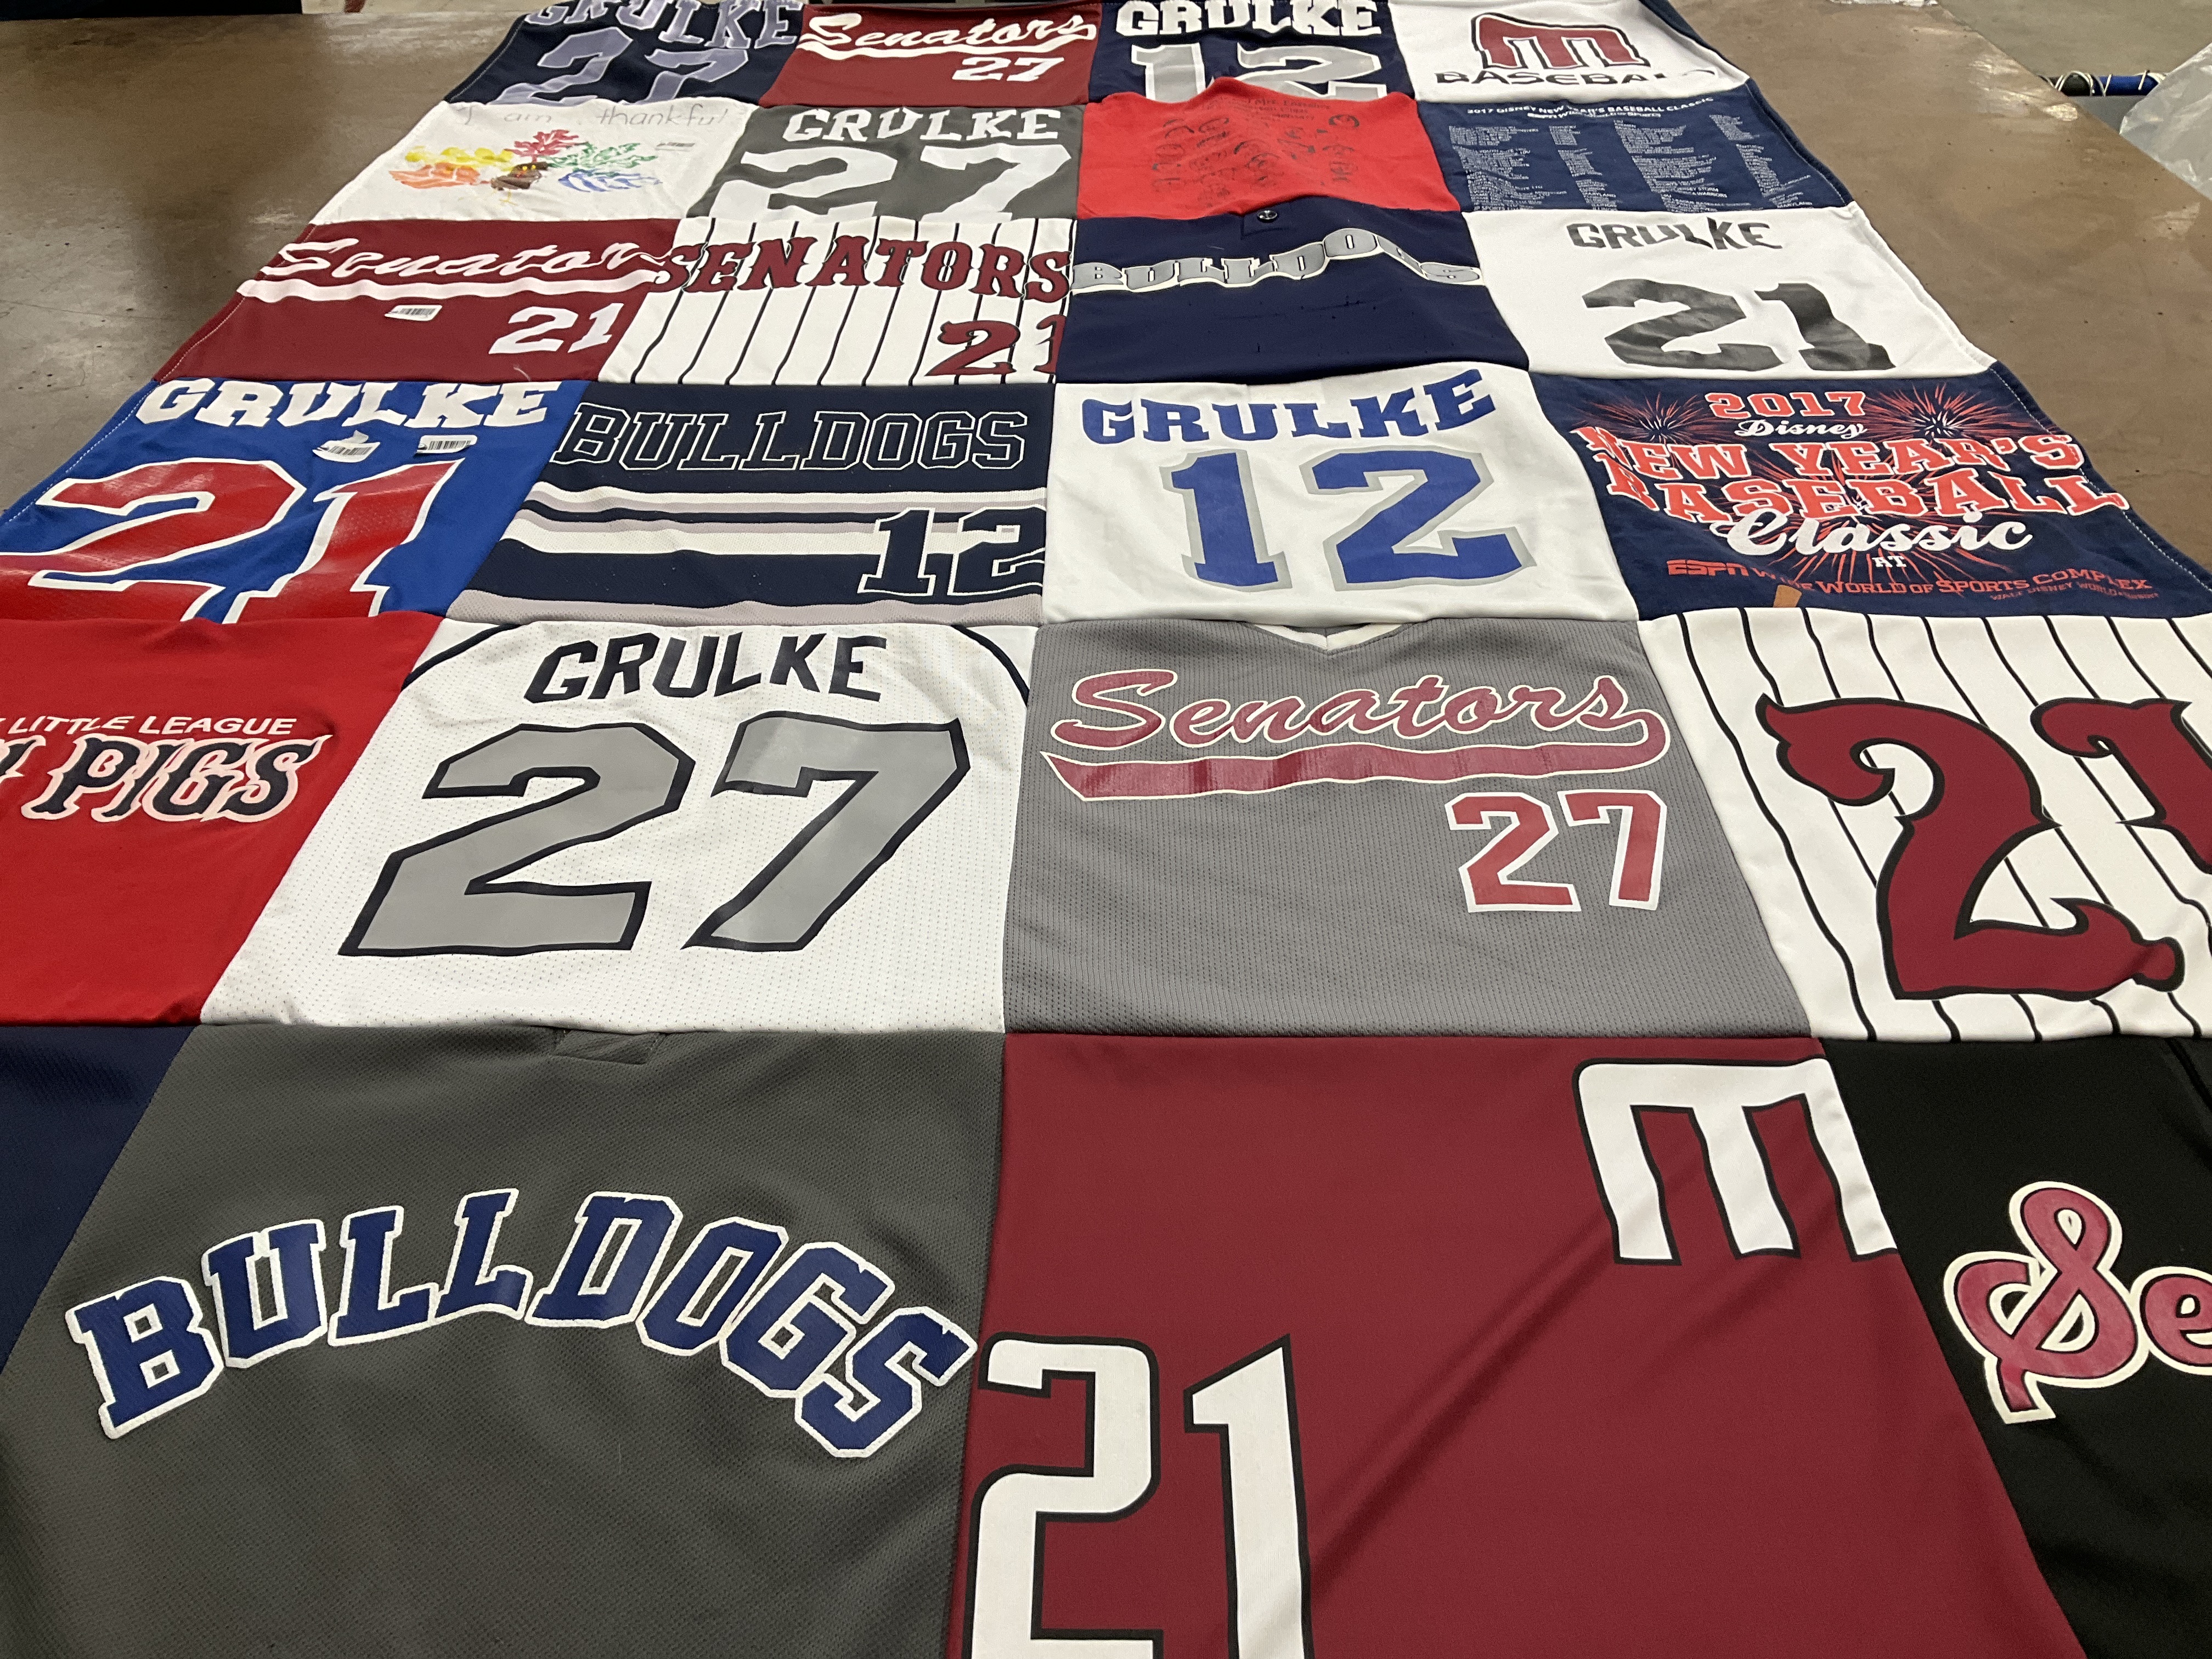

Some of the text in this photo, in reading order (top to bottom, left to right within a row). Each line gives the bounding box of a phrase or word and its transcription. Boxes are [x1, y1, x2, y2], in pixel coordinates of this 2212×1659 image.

[797, 13, 1096, 57] Senators
[1116, 0, 1381, 36] GRULKE
[487, 27, 749, 105] 27
[952, 57, 1064, 81] 27
[1131, 42, 1387, 103] 12
[504, 112, 552, 123] am
[596, 104, 733, 127] thankful
[782, 107, 1062, 142] GRULKE
[708, 144, 1072, 224] 27
[1566, 217, 1782, 250] GRULKE
[649, 235, 1072, 303] SENATORS
[488, 303, 624, 354] 21
[925, 313, 1067, 376] 21
[1582, 278, 1897, 372] 21
[135, 378, 561, 428] GRULKE
[1081, 368, 1496, 445] GRULKE
[1705, 391, 1866, 419] 2017
[1734, 419, 1868, 439] Disney
[549, 402, 1029, 471] BULLDOGS
[1568, 426, 2083, 481] NEW YEAR'S
[1159, 445, 1537, 592] 12
[1592, 452, 2132, 523] BASEBALL
[0, 457, 466, 624] 21
[856, 504, 1046, 597] 12
[1709, 505, 2033, 556] Classic
[1872, 555, 1906, 568] AT
[1667, 560, 1749, 577] ESPN
[1815, 580, 1908, 594] WORLD
[1909, 584, 1934, 594] OF
[1935, 578, 2030, 594] SPORTS
[523, 631, 887, 704] GRULKE
[7, 715, 297, 735] LITTLE LEAGUE
[1042, 669, 1671, 787] Senators
[21, 733, 334, 823] PIGS
[336, 710, 971, 957] 27
[1444, 789, 1668, 913] 27
[64, 1186, 978, 1459] BULLDOGS
[962, 1334, 1315, 1659] 21
